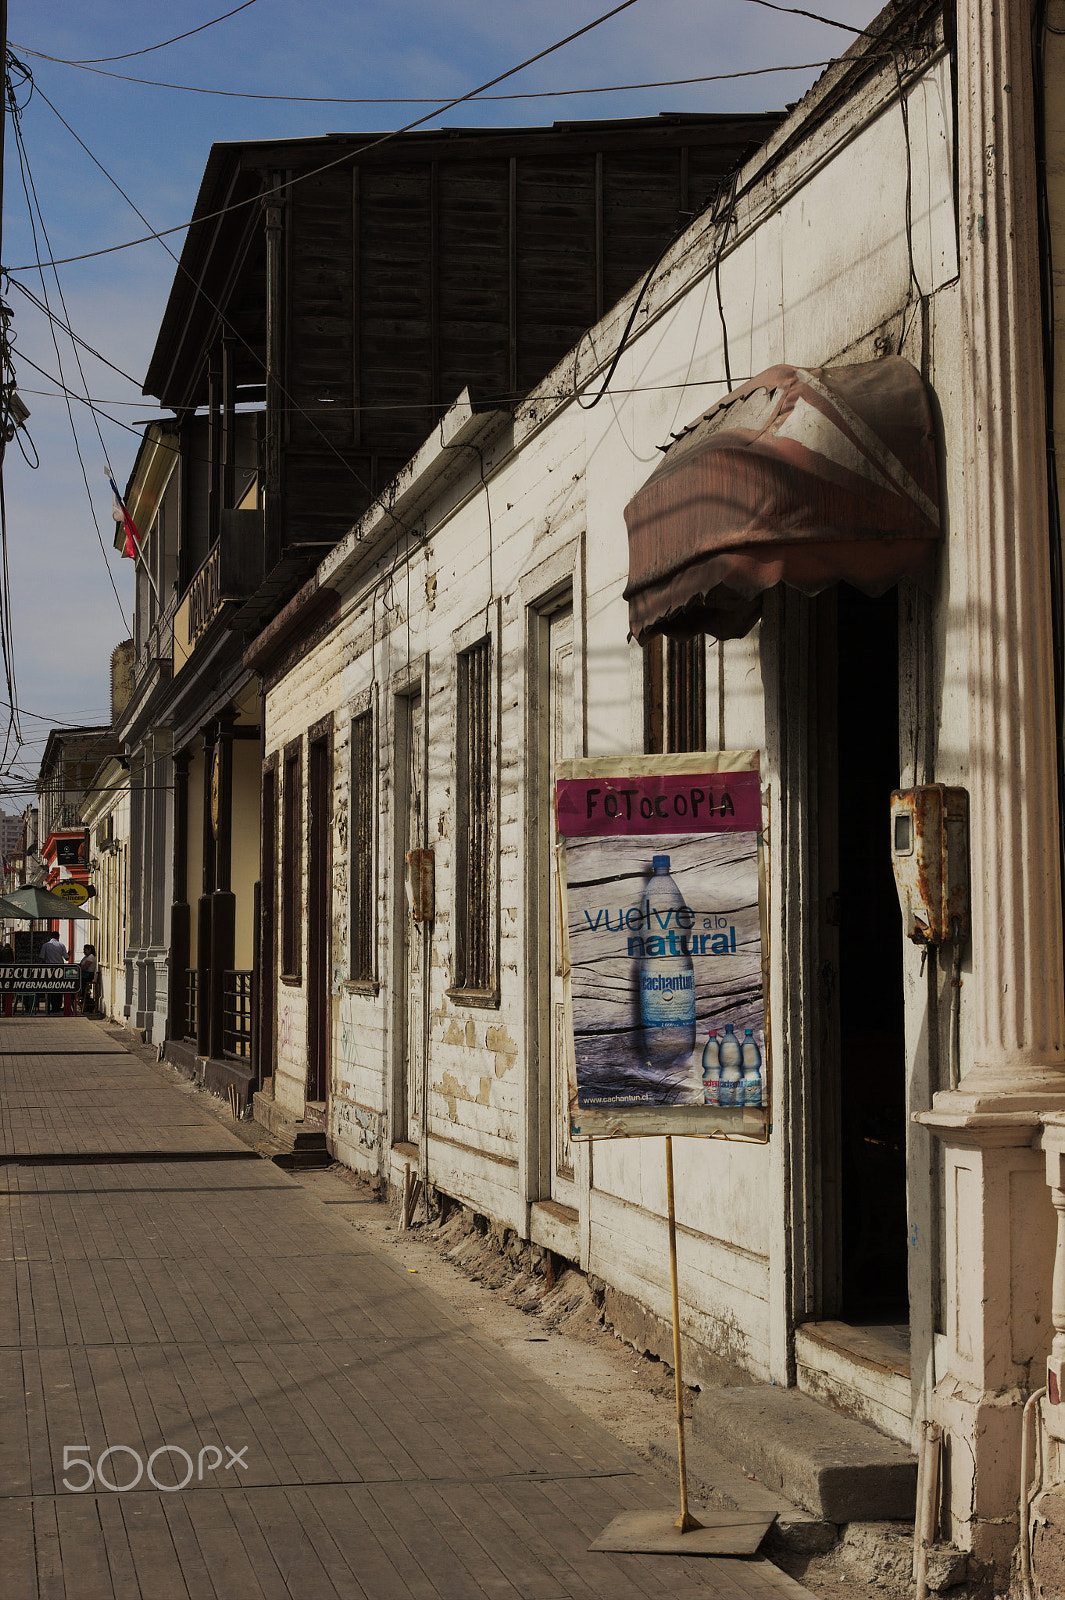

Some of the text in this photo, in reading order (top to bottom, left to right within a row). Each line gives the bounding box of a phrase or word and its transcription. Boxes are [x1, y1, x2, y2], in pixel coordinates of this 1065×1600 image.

[586, 787, 736, 821] FOTOCOPIA
[584, 899, 696, 932] vuelve
[627, 926, 737, 957] natural
